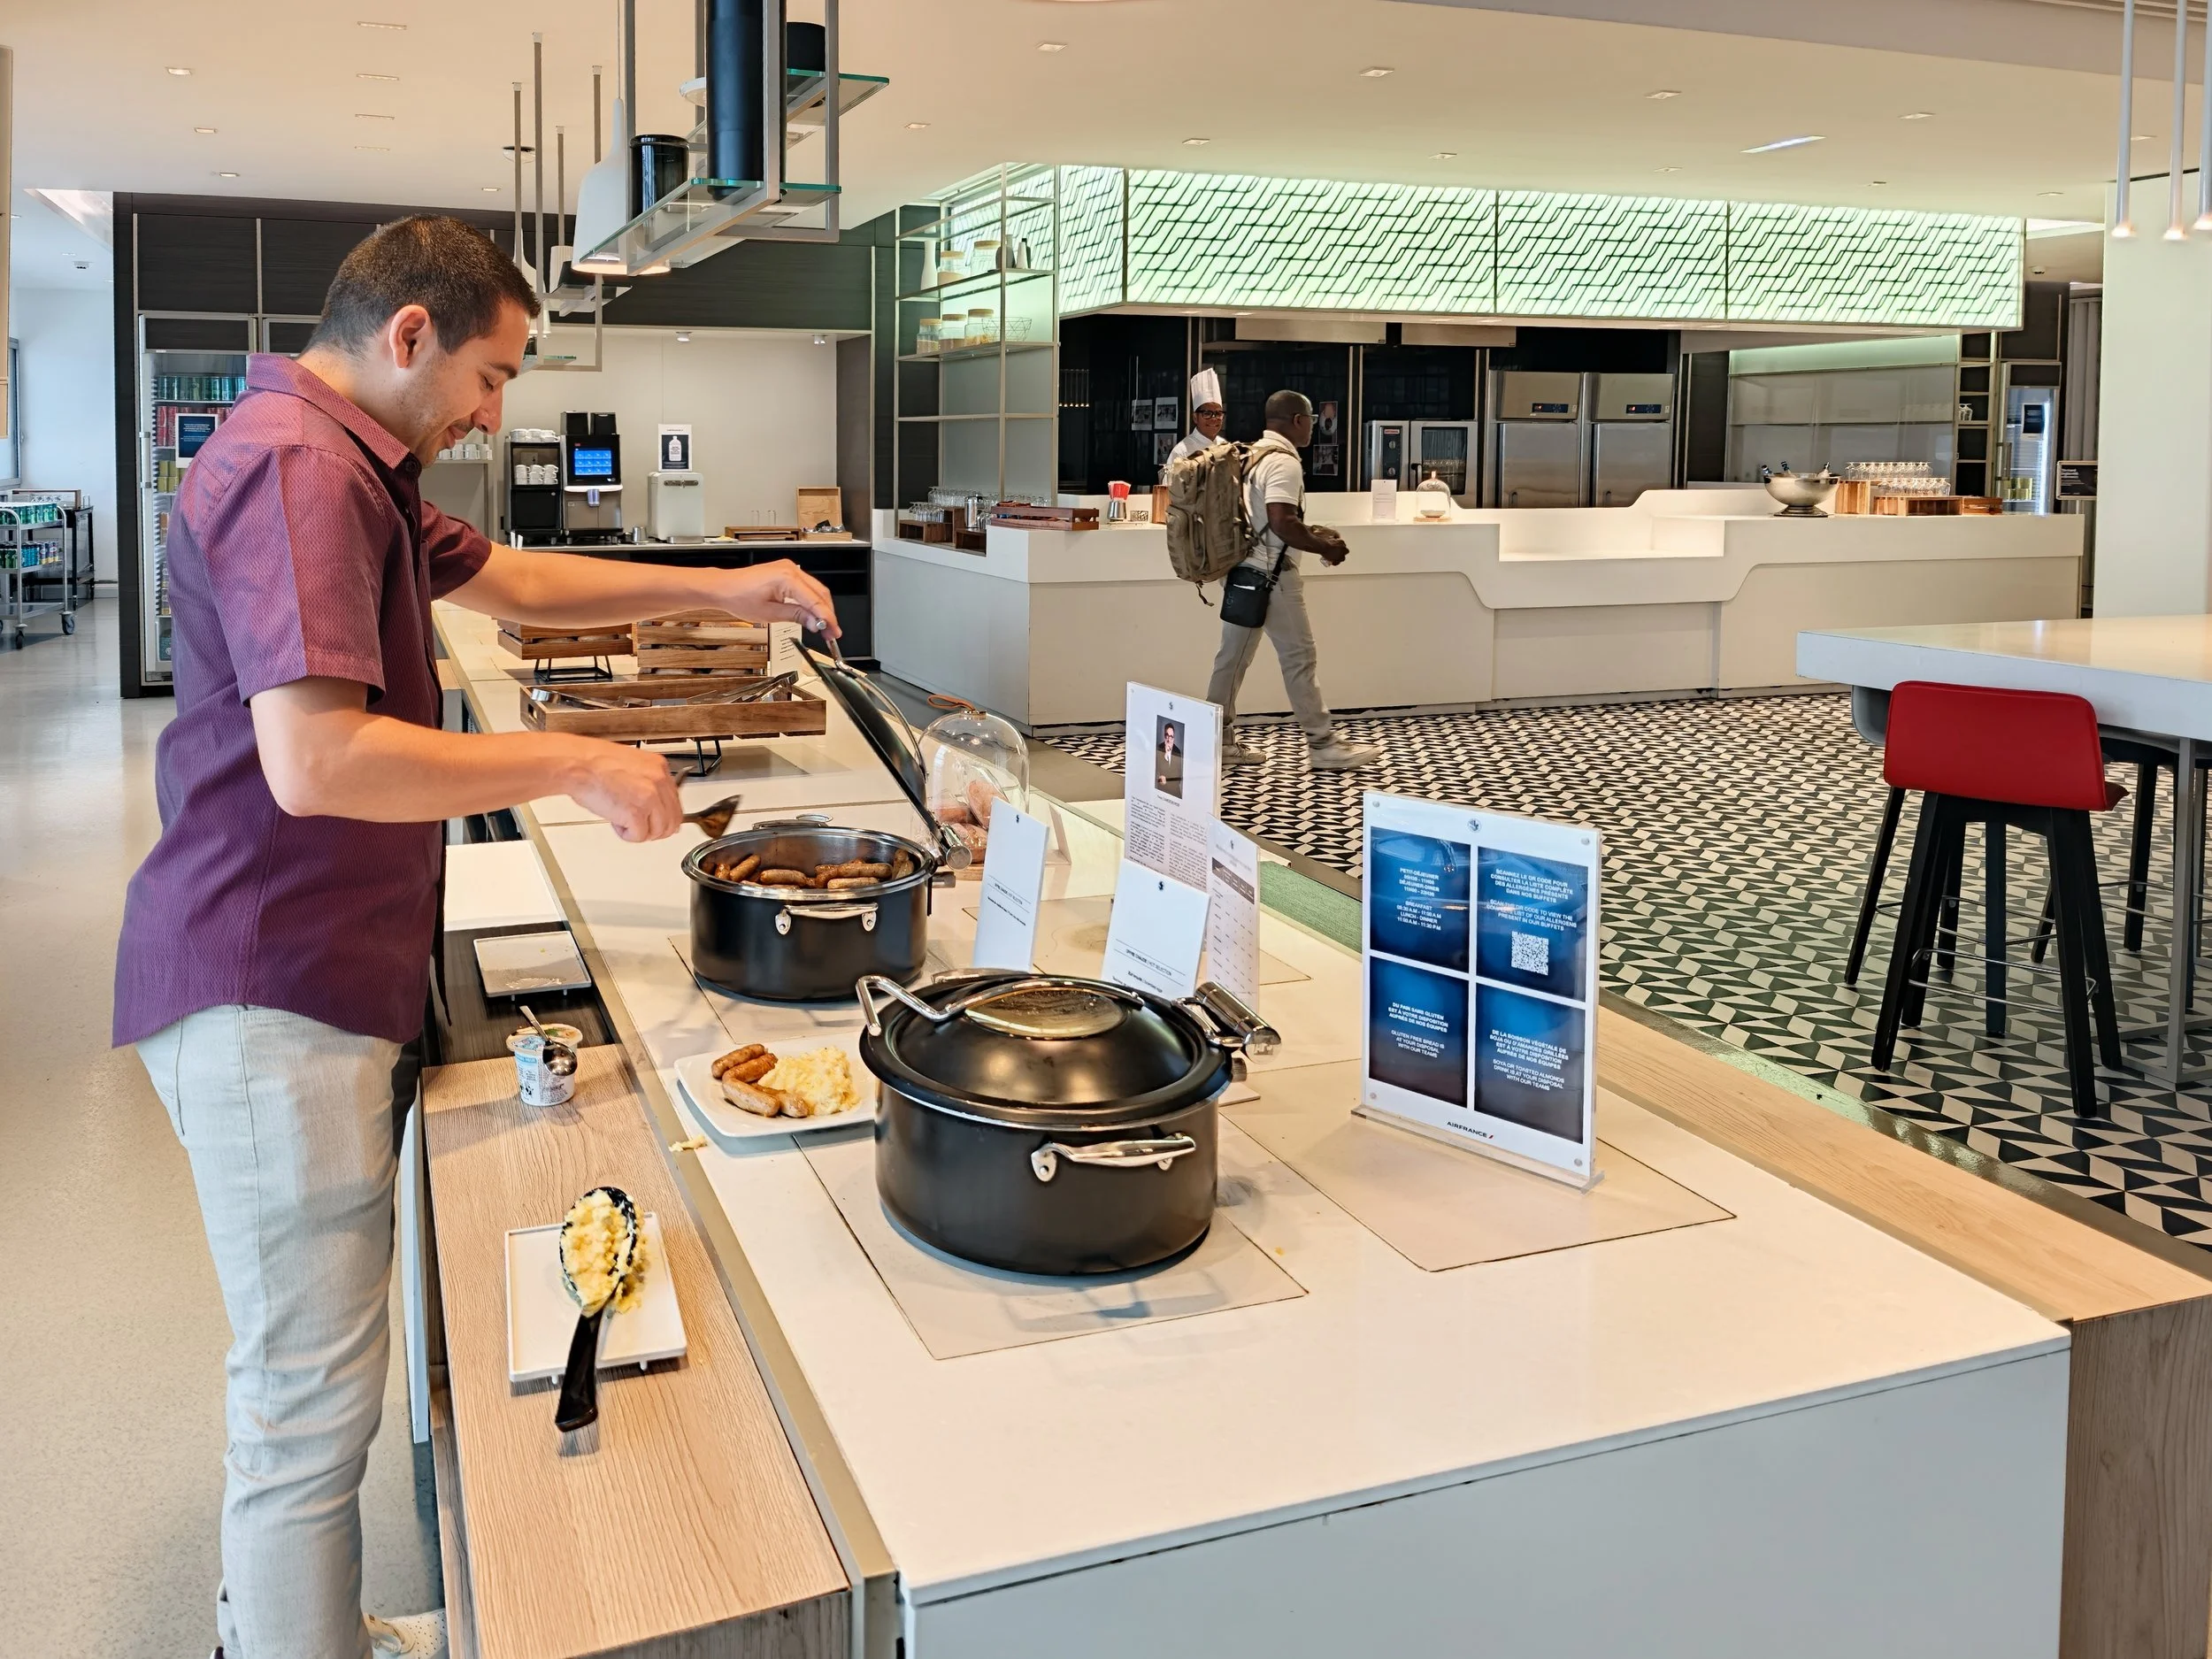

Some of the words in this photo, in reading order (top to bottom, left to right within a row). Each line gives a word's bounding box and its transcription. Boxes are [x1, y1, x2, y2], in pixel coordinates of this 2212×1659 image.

[1491, 873, 1520, 884] CONSULTER
[1496, 869, 1519, 878] SCANNEZ
[1533, 894, 1556, 903] BUFFETS
[1405, 901, 1432, 910] BREAKFAST
[1525, 906, 1539, 914] CODE
[1419, 915, 1437, 924] DINNER
[1498, 912, 1521, 922] PRESENT
[1541, 921, 1564, 931] BUFFETS
[1546, 917, 1576, 928] ALLERGENS
[1402, 1011, 1417, 1019] VOTRE
[1419, 1015, 1448, 1027] DISPOSITION
[1425, 1011, 1444, 1020] GLUTEN
[1391, 1030, 1409, 1038] GLUTEN
[1423, 1038, 1439, 1047] BREAD
[1508, 1033, 1530, 1044] BOISSON
[1416, 1042, 1439, 1053] DISPOSAL
[1422, 1049, 1437, 1058] TEAMS
[1512, 1046, 1528, 1055] VOTRE
[1530, 1051, 1561, 1064] DISPOSITION
[1494, 1065, 1509, 1073] DRINK
[1538, 1077, 1563, 1089] DISPOSAL
[1516, 1065, 1539, 1076] TOASTED
[1540, 1072, 1564, 1083] ALMONDS
[1532, 1082, 1550, 1091] TEAMS
[1447, 1121, 1487, 1138] AIRFRANCE
